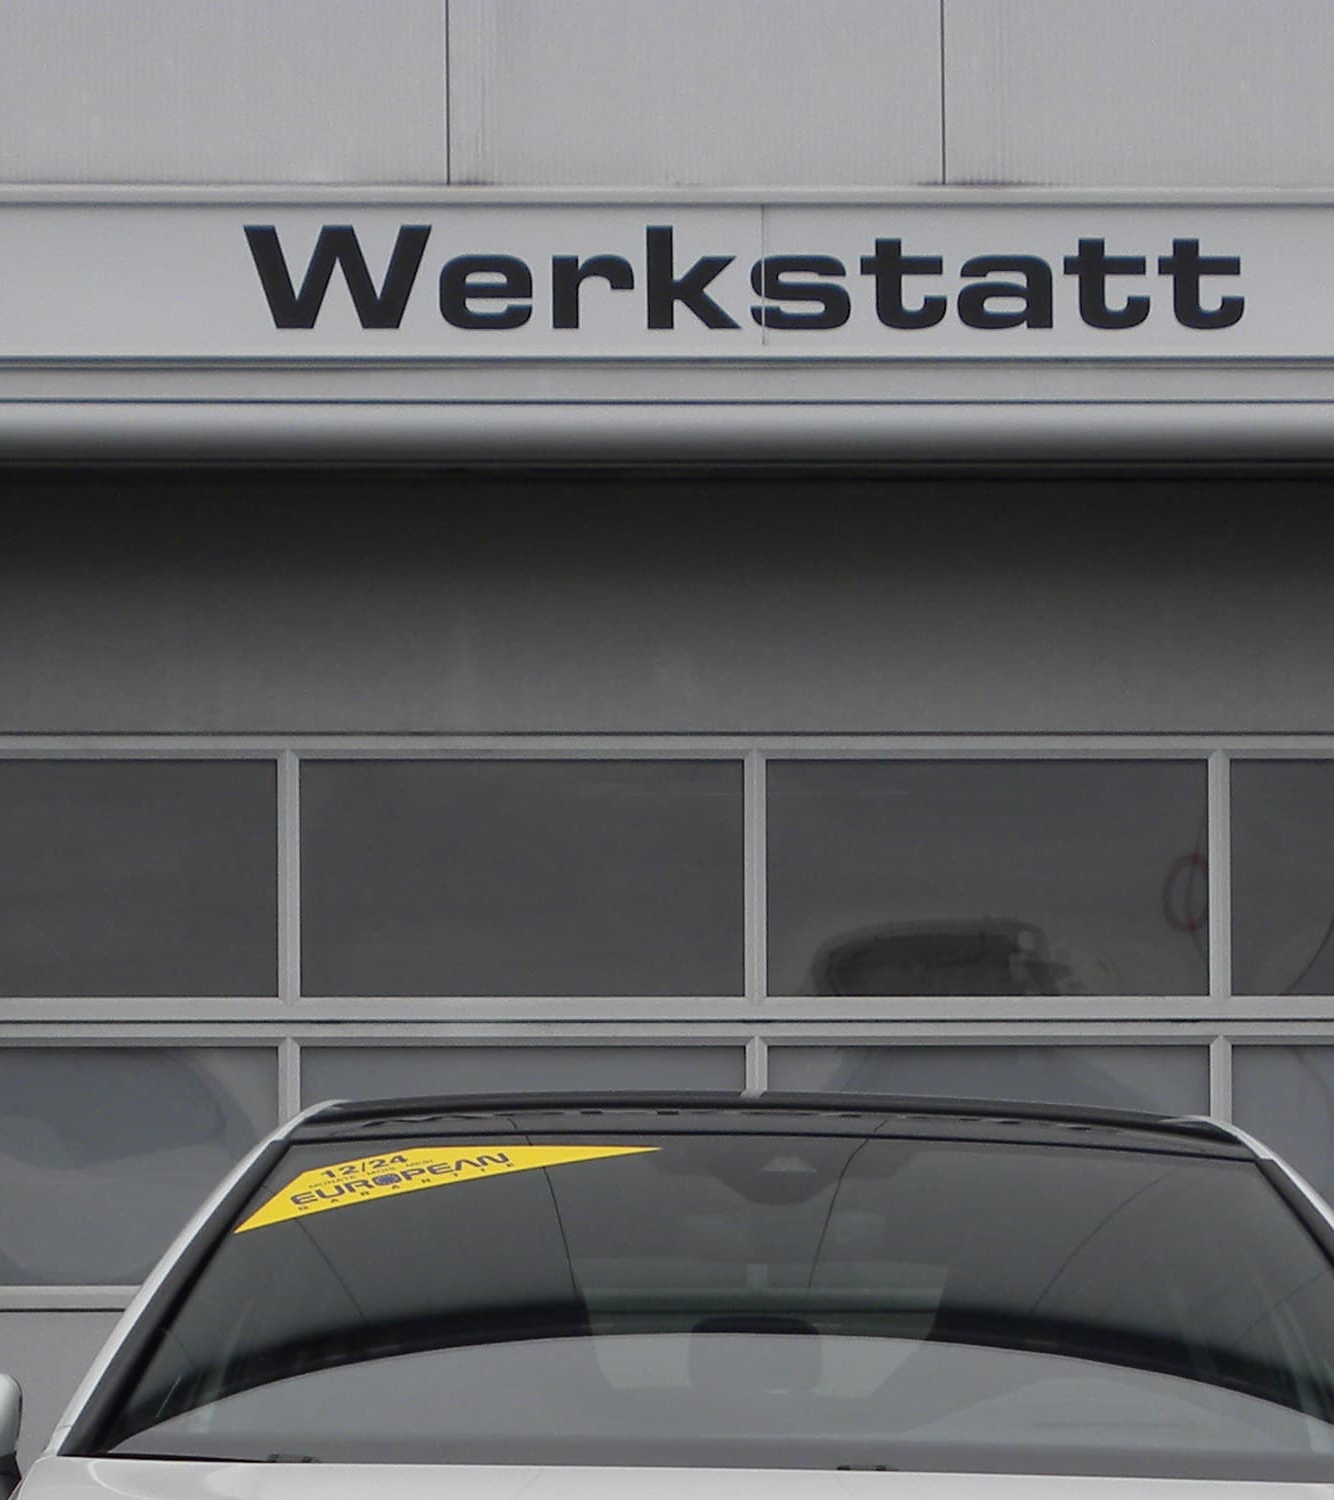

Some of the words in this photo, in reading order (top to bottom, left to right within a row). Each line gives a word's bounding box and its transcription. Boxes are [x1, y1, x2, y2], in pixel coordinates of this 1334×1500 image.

[243, 226, 1245, 331] Werkstatt
[289, 1152, 510, 1206] EUROPEAN
[321, 1154, 408, 1179] 12/24
